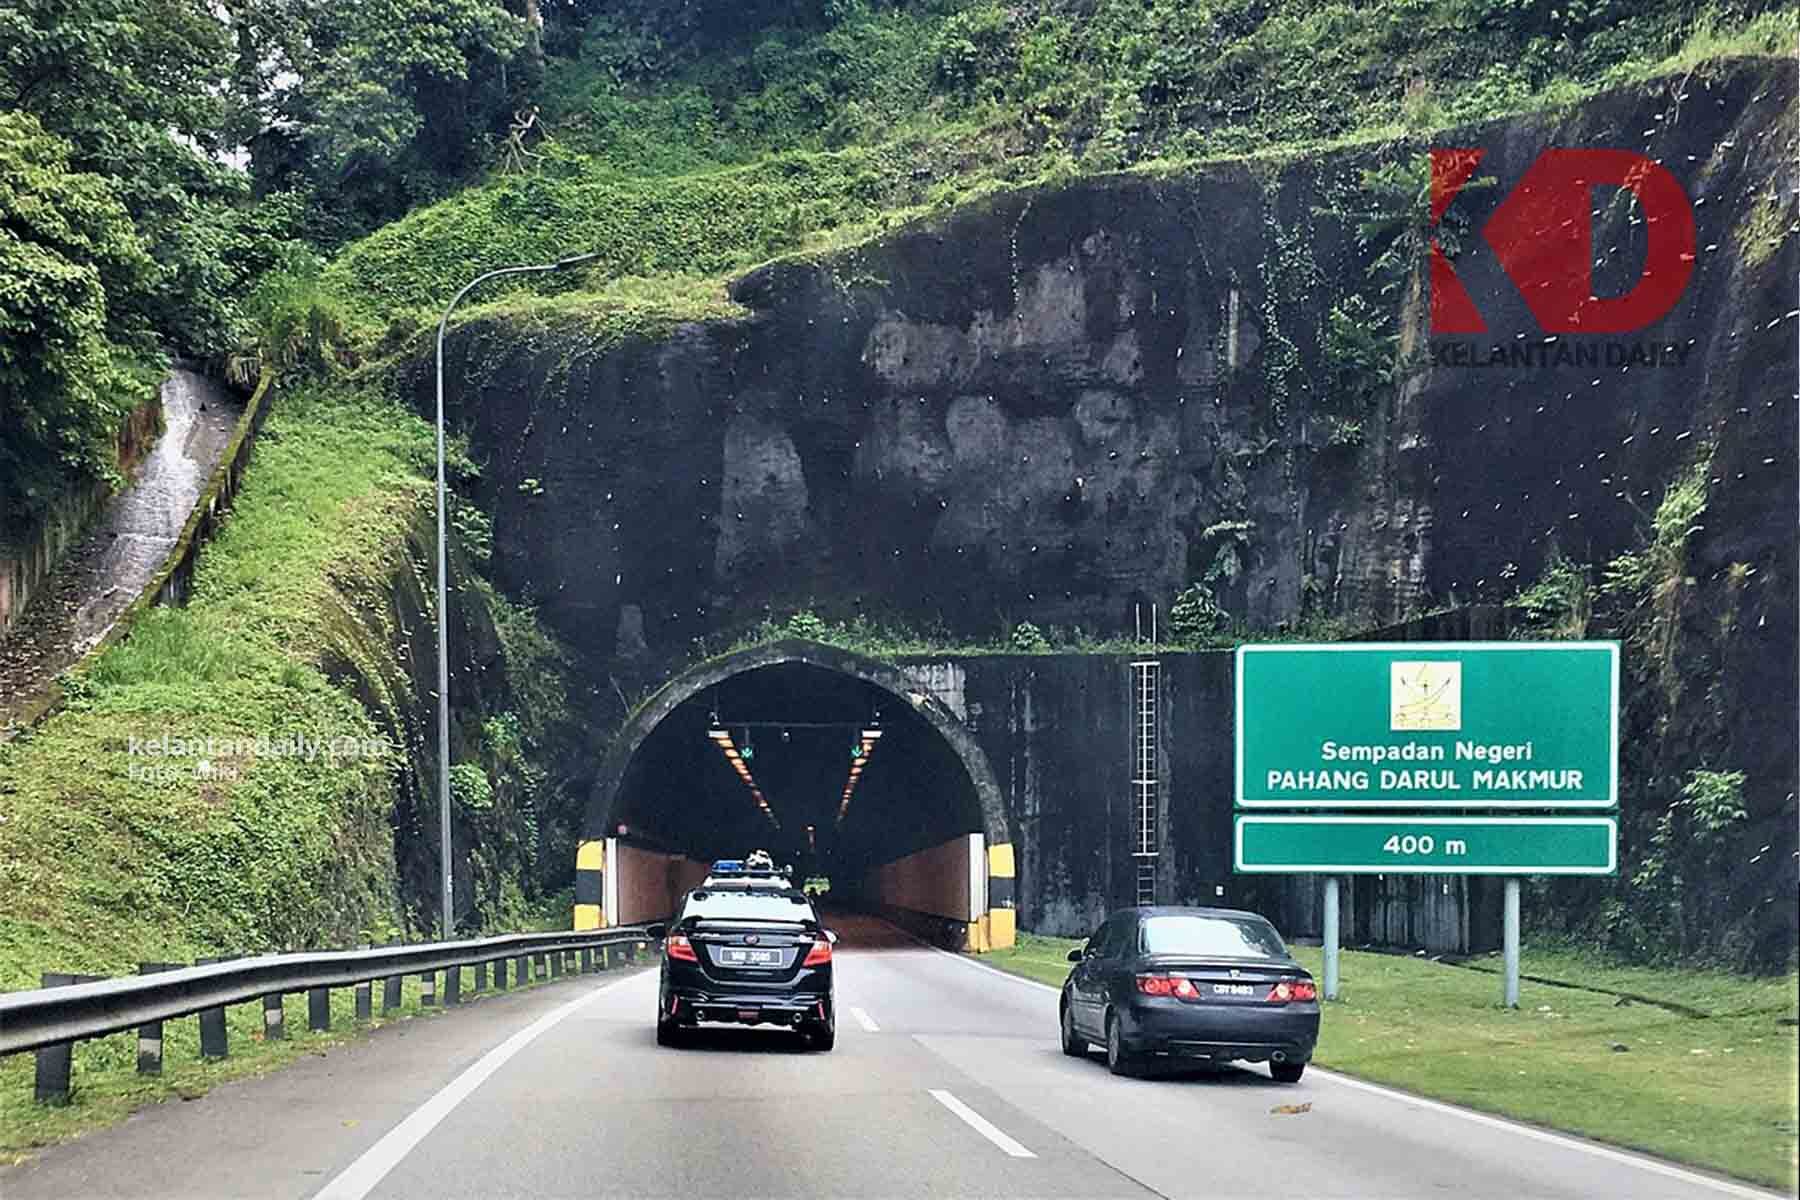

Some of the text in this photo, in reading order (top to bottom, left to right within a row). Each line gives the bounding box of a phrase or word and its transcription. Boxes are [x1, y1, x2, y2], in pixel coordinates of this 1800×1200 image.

[1321, 741, 1532, 763] Sempadan Negeri
[1267, 769, 1583, 790] PAHANG DARUL MAKMUR
[1383, 835, 1466, 854] 400 m
